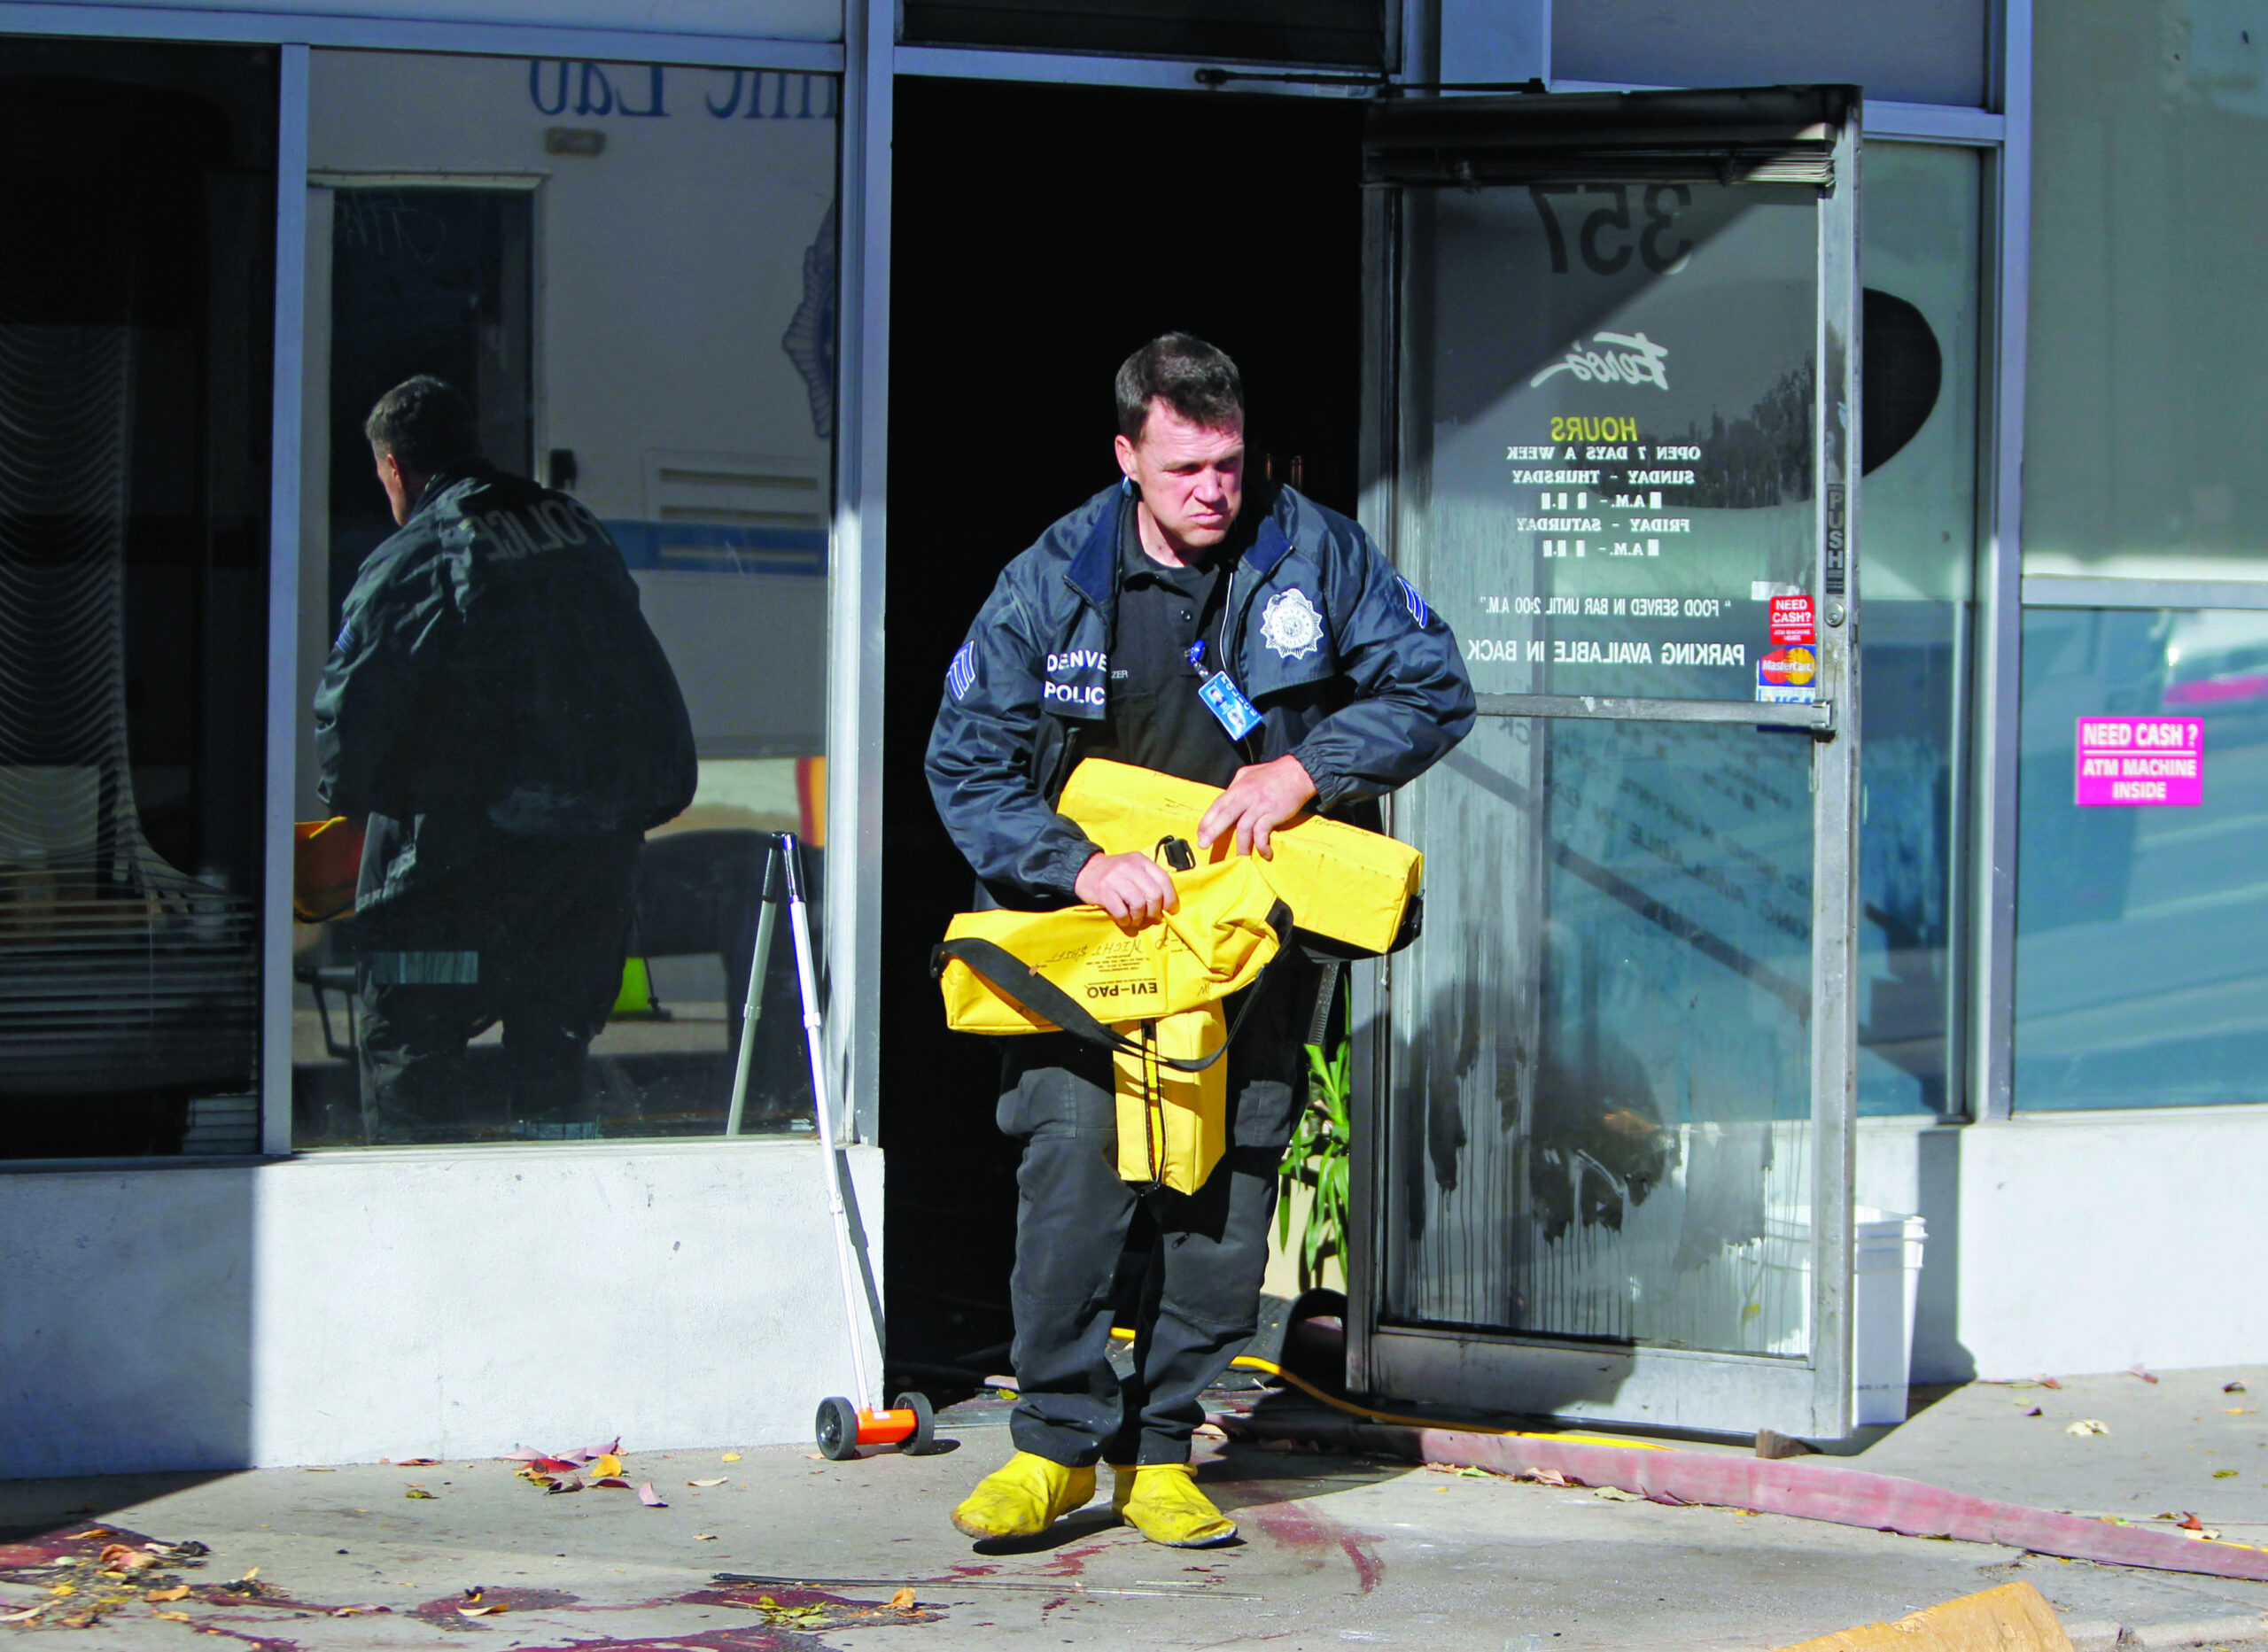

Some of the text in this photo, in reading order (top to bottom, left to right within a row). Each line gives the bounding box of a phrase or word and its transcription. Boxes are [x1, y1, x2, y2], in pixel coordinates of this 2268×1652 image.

[1828, 491, 1844, 568] PUSH
[1775, 600, 1807, 610] NEED
[1773, 612, 1812, 623] CASH?
[1046, 649, 1107, 672] DENVE
[1111, 670, 1128, 679] ZER
[1044, 680, 1106, 705] POLIC
[2083, 722, 2132, 745] NEED
[2135, 722, 2184, 746] CASH
[2083, 758, 2197, 776] ATM MACHINE
[2112, 781, 2167, 798] INSIDE
[1084, 981, 1158, 999] EVI-PAQ
